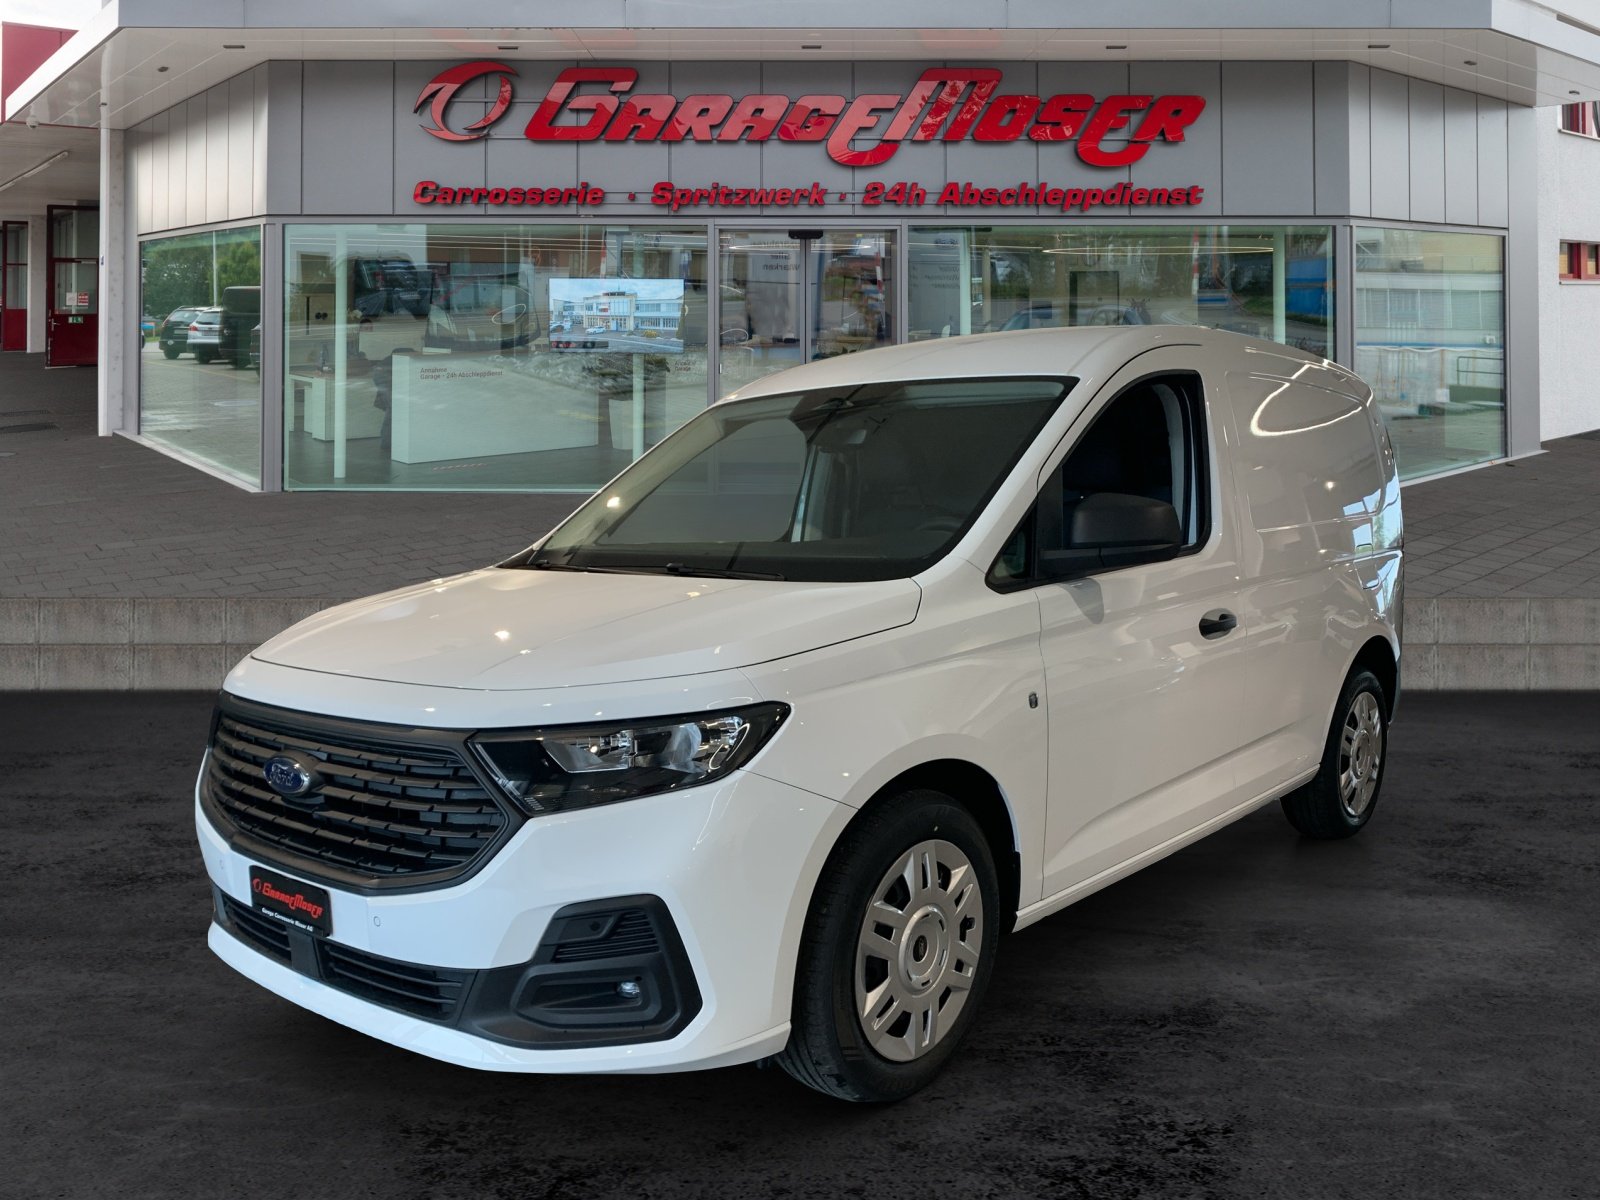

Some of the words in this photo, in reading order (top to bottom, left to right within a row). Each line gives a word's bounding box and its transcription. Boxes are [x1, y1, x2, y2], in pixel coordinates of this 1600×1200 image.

[413, 181, 604, 205] Carrosserie
[651, 181, 826, 211] Spritzwerk
[862, 182, 926, 205] 24h
[936, 182, 1204, 211] Abschleppdienst
